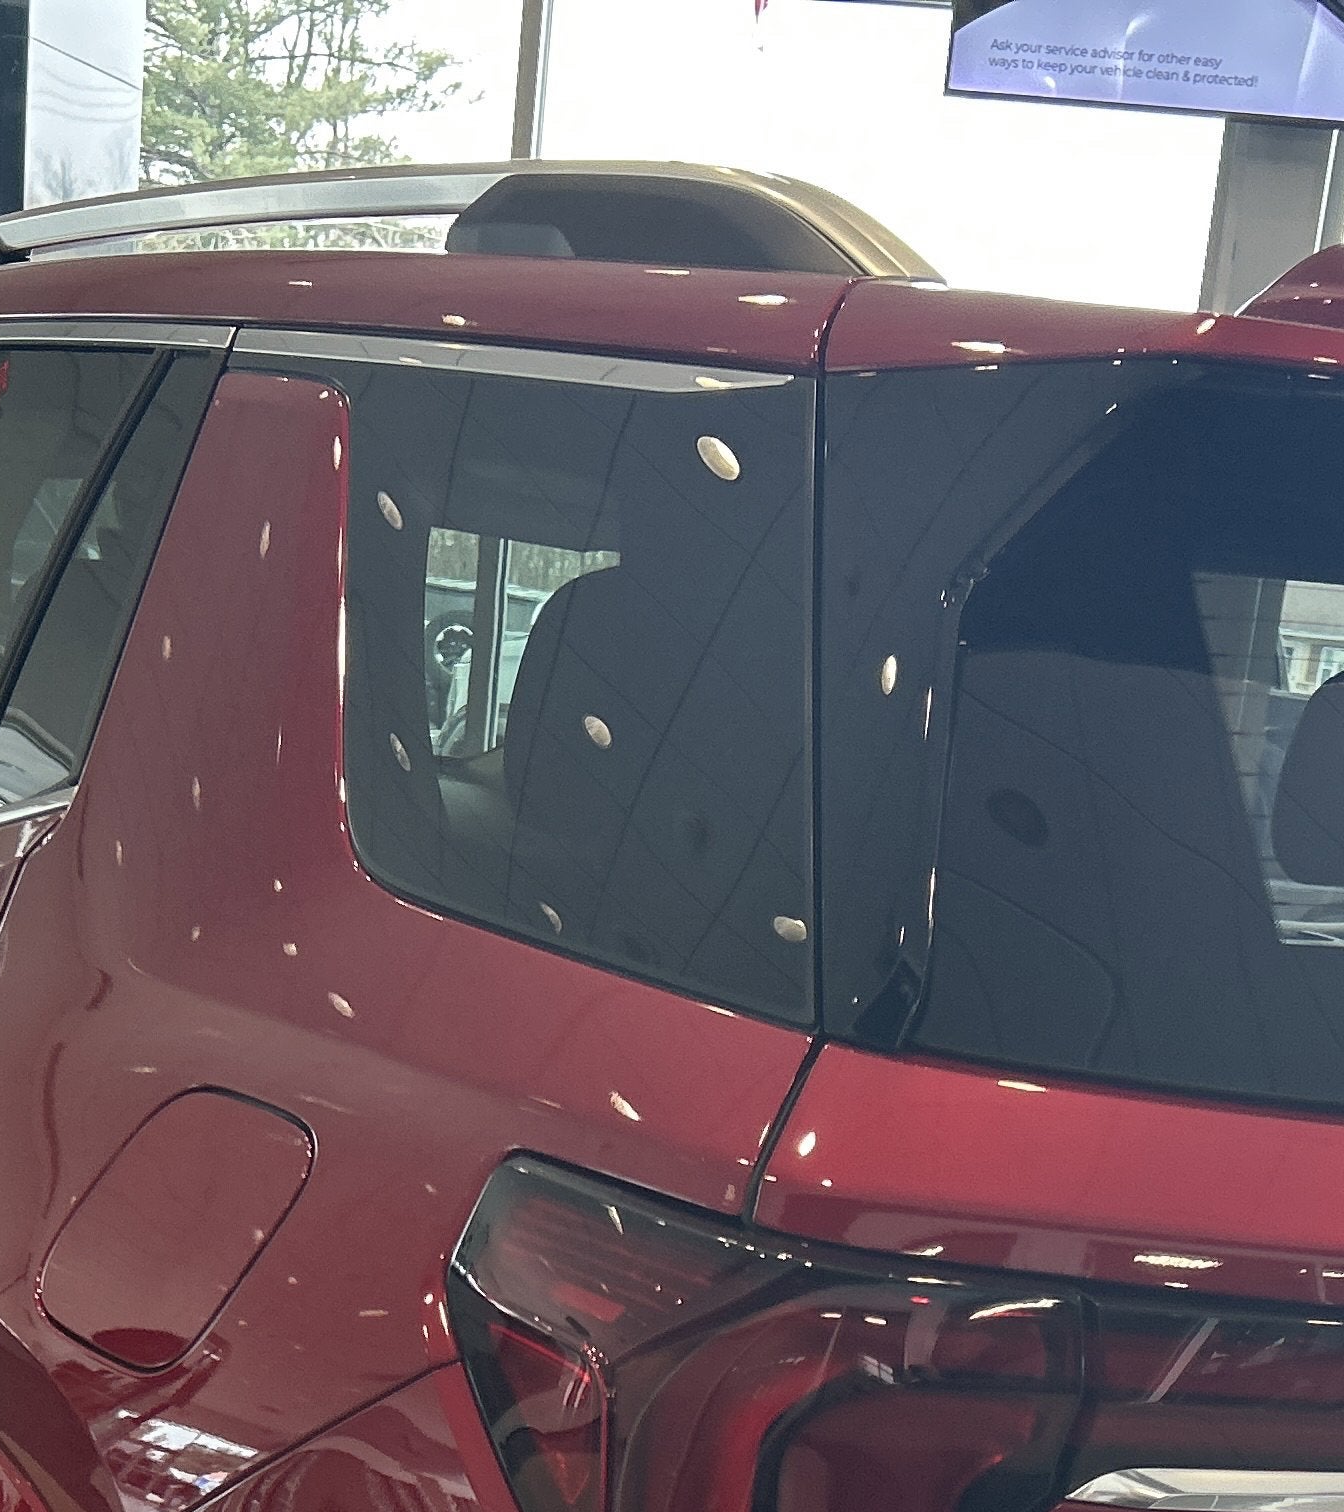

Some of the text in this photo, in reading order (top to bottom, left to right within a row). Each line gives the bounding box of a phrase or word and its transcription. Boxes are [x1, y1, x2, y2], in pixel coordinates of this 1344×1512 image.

[990, 38, 1223, 70] Ask your service advisor for other easy
[988, 57, 1259, 88] ways to keep your vehicle clean & protected!
